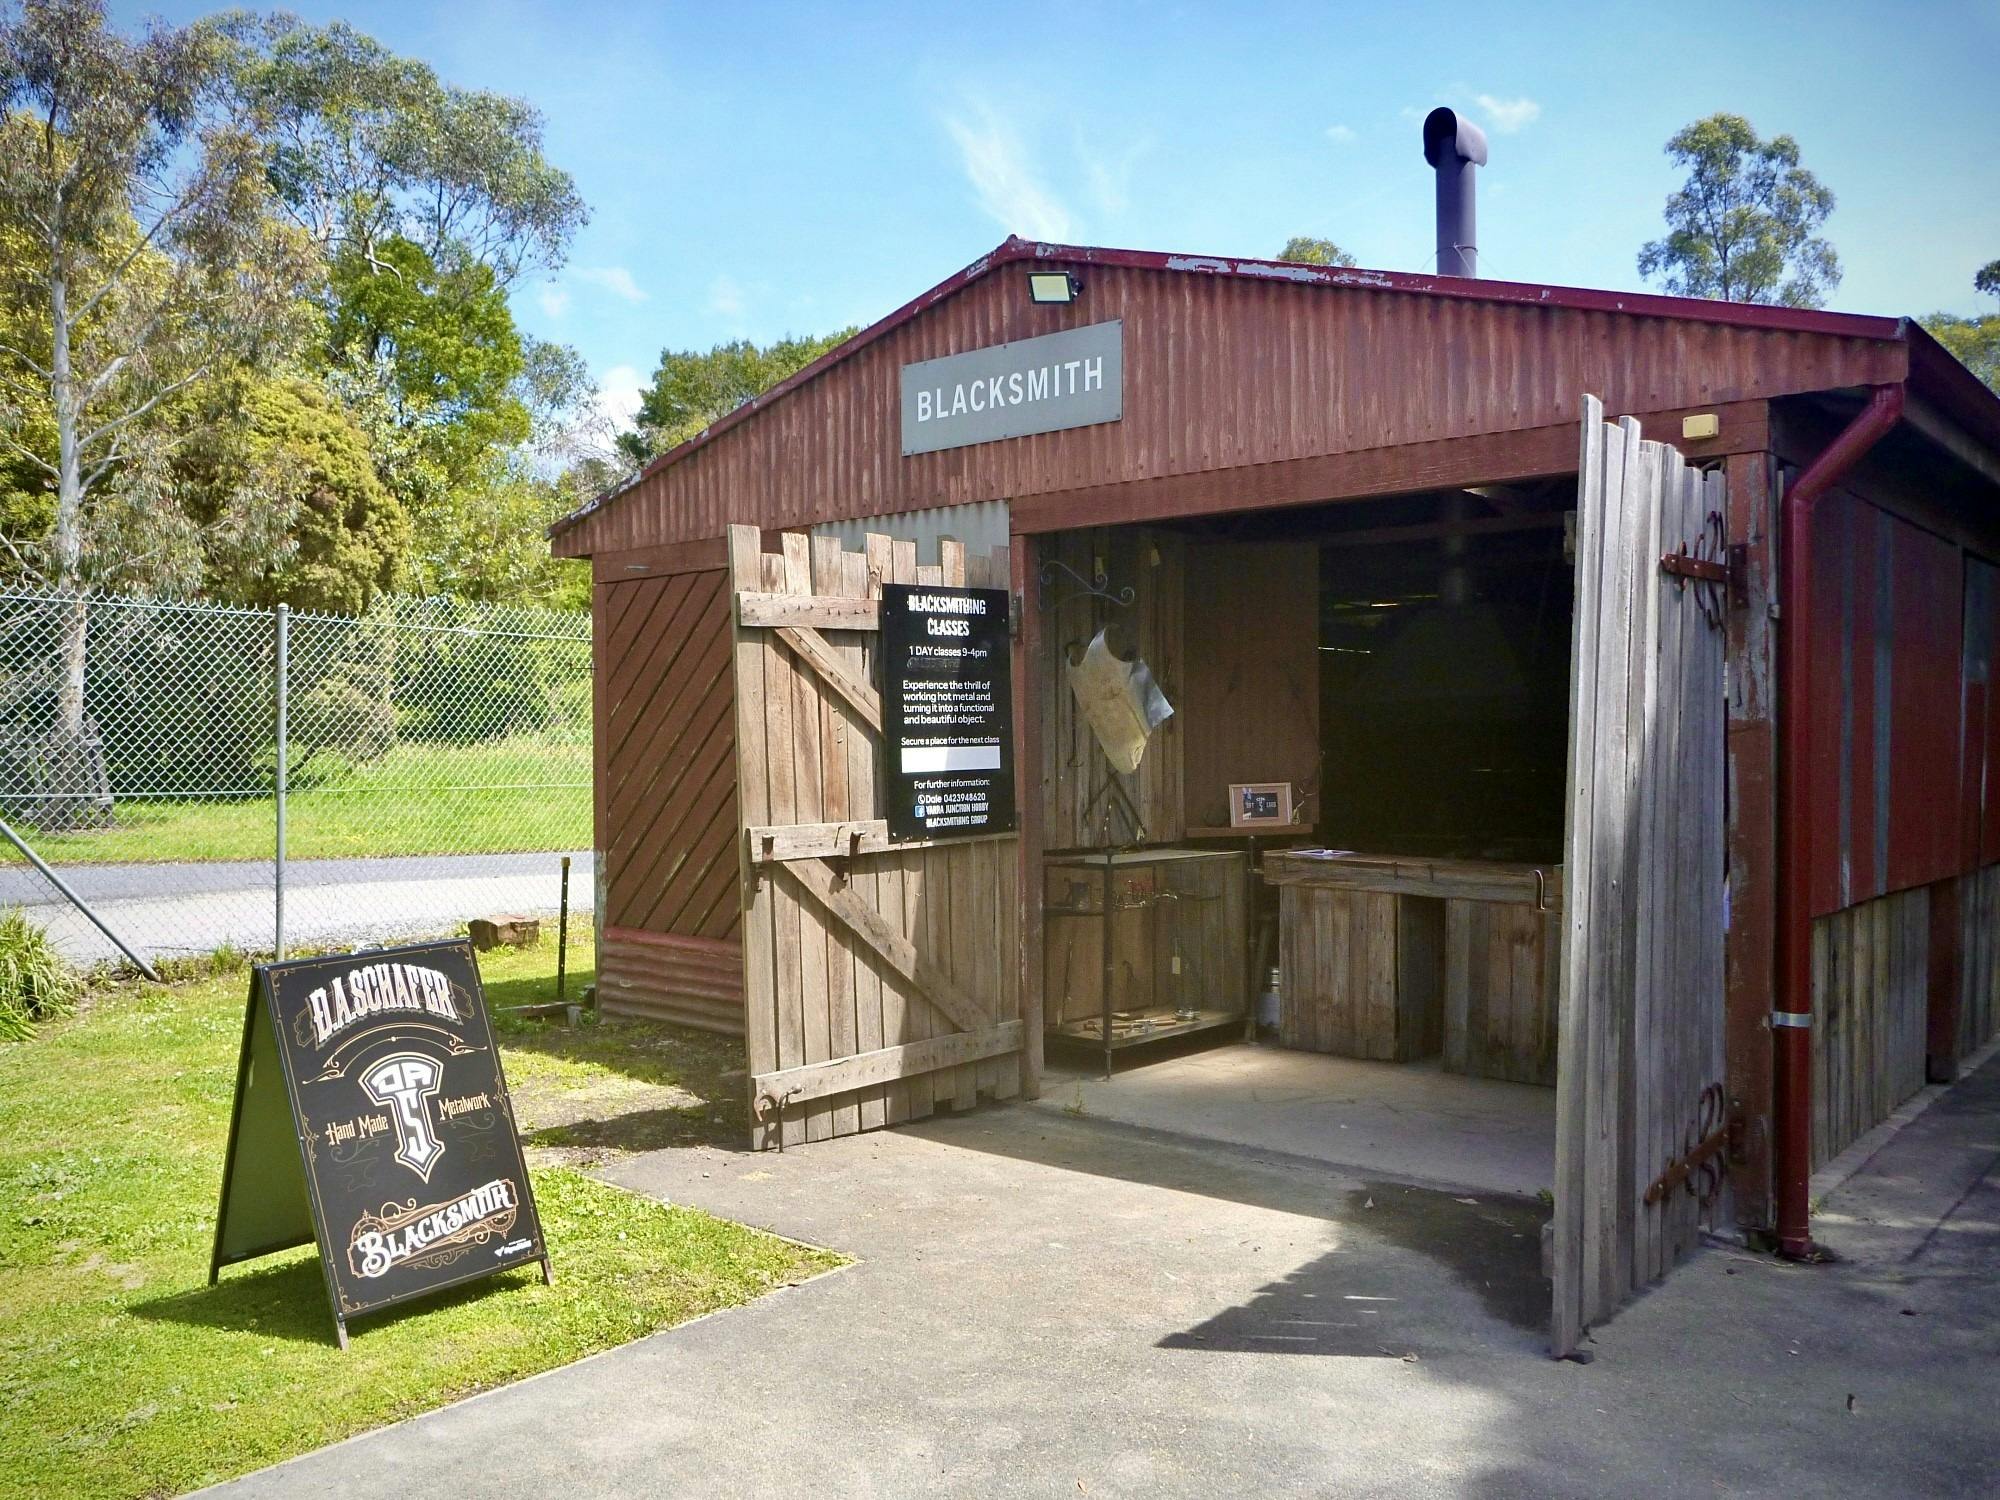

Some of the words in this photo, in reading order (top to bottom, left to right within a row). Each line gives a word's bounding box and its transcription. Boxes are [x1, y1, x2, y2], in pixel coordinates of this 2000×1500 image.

[917, 356, 1103, 423] BLACKSMITH
[907, 594, 987, 615] BLACKSMITHING
[927, 617, 970, 637] CLASSES
[908, 645, 914, 656] 1
[915, 645, 934, 656] DAY
[933, 646, 961, 657] classes
[962, 647, 987, 659] 9-4pm
[902, 680, 948, 691] Experience
[949, 680, 963, 690] the
[964, 681, 981, 690] thrill
[981, 681, 991, 690] of
[903, 692, 936, 703] working
[937, 692, 952, 701] hot
[953, 692, 975, 701] metal
[976, 692, 991, 701] and
[903, 703, 931, 714] turning
[931, 703, 938, 712] it
[938, 704, 953, 713] into
[960, 704, 995, 712] functional
[903, 715, 919, 724] and
[920, 715, 957, 724] beautiful
[957, 715, 985, 725] object.
[901, 737, 925, 746] Secure
[930, 737, 948, 746] place
[948, 736, 957, 744] for
[958, 736, 969, 744] the
[969, 736, 984, 744] next
[914, 781, 927, 790] For
[927, 779, 950, 789] further
[950, 778, 990, 787] information:
[925, 794, 943, 804] Dale
[926, 804, 945, 815] YARRA
[945, 803, 971, 814] JUNCTION
[970, 815, 988, 825] GROUP
[438, 1091, 491, 1122] Metalwork
[325, 1120, 356, 1146] Hand
[357, 1113, 390, 1140] Made
